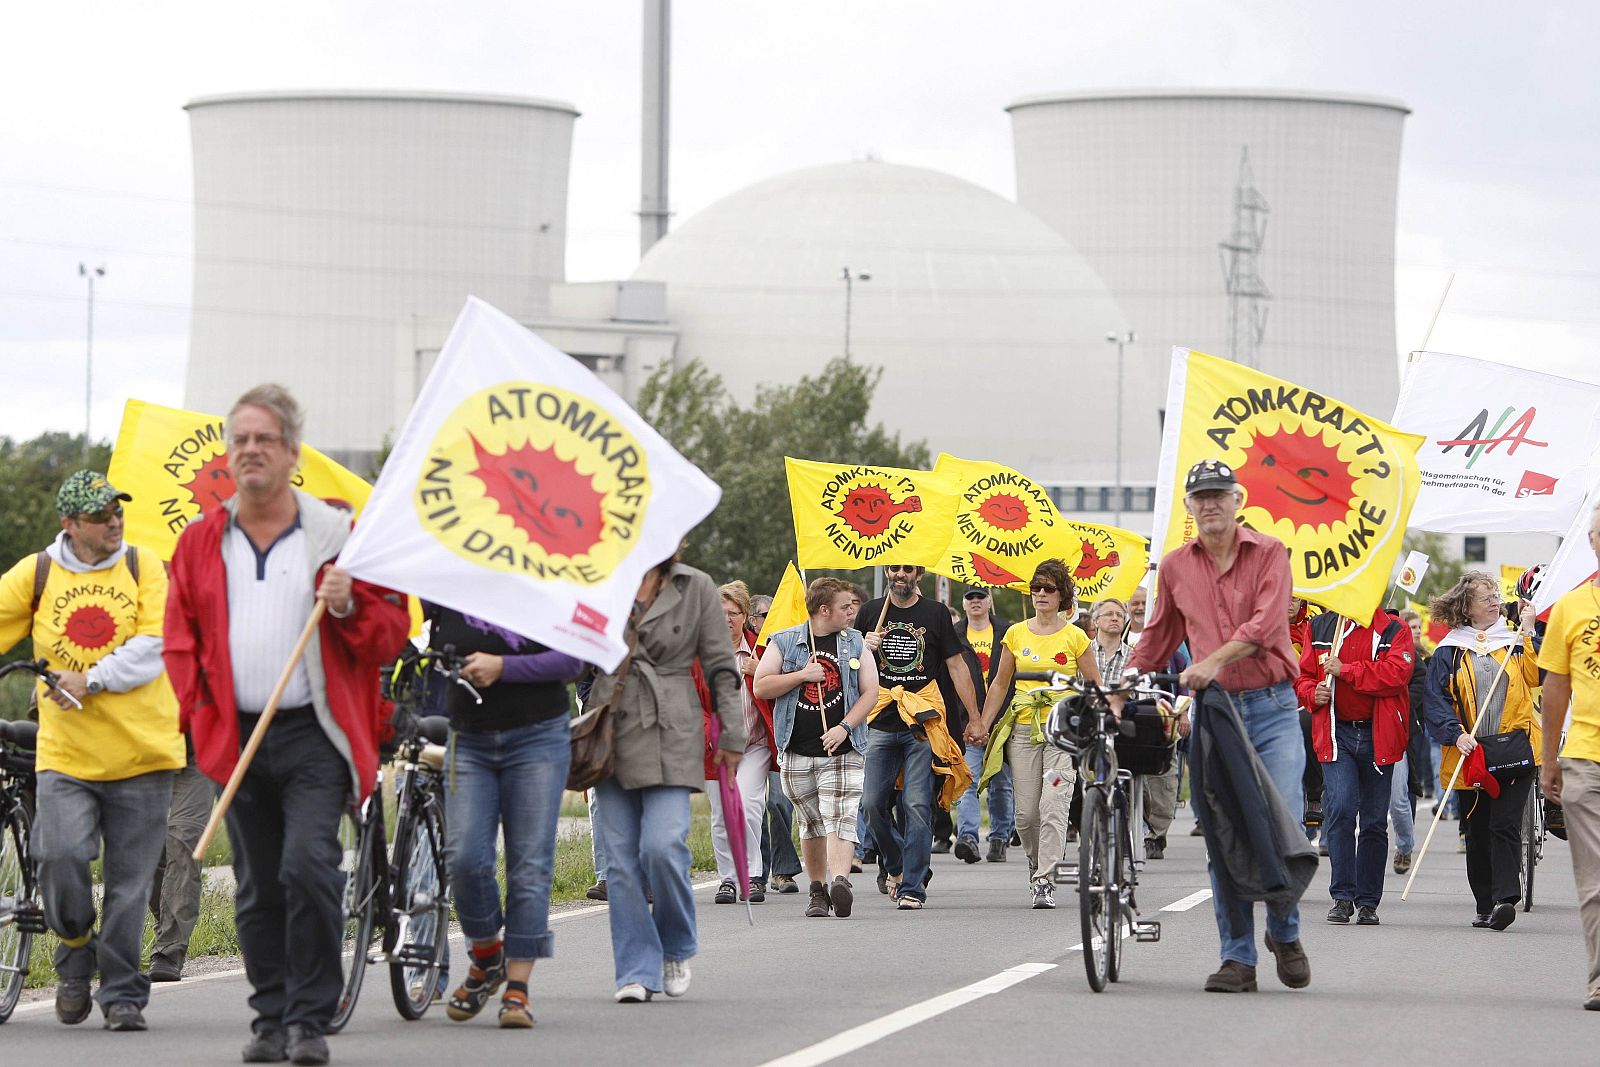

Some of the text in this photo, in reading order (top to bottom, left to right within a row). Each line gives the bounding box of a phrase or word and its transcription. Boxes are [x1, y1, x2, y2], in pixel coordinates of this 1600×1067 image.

[1206, 386, 1391, 479] ATOMKRAFT?
[963, 473, 1054, 527] ATOMKRAFT?
[1481, 484, 1490, 492] in
[1492, 488, 1507, 497] der
[1493, 477, 1505, 487] für
[462, 529, 605, 584] DANKE
[825, 520, 914, 561] NEIN DANKE
[957, 513, 1044, 557] NEIN DANKE
[1304, 500, 1387, 579] DANKE
